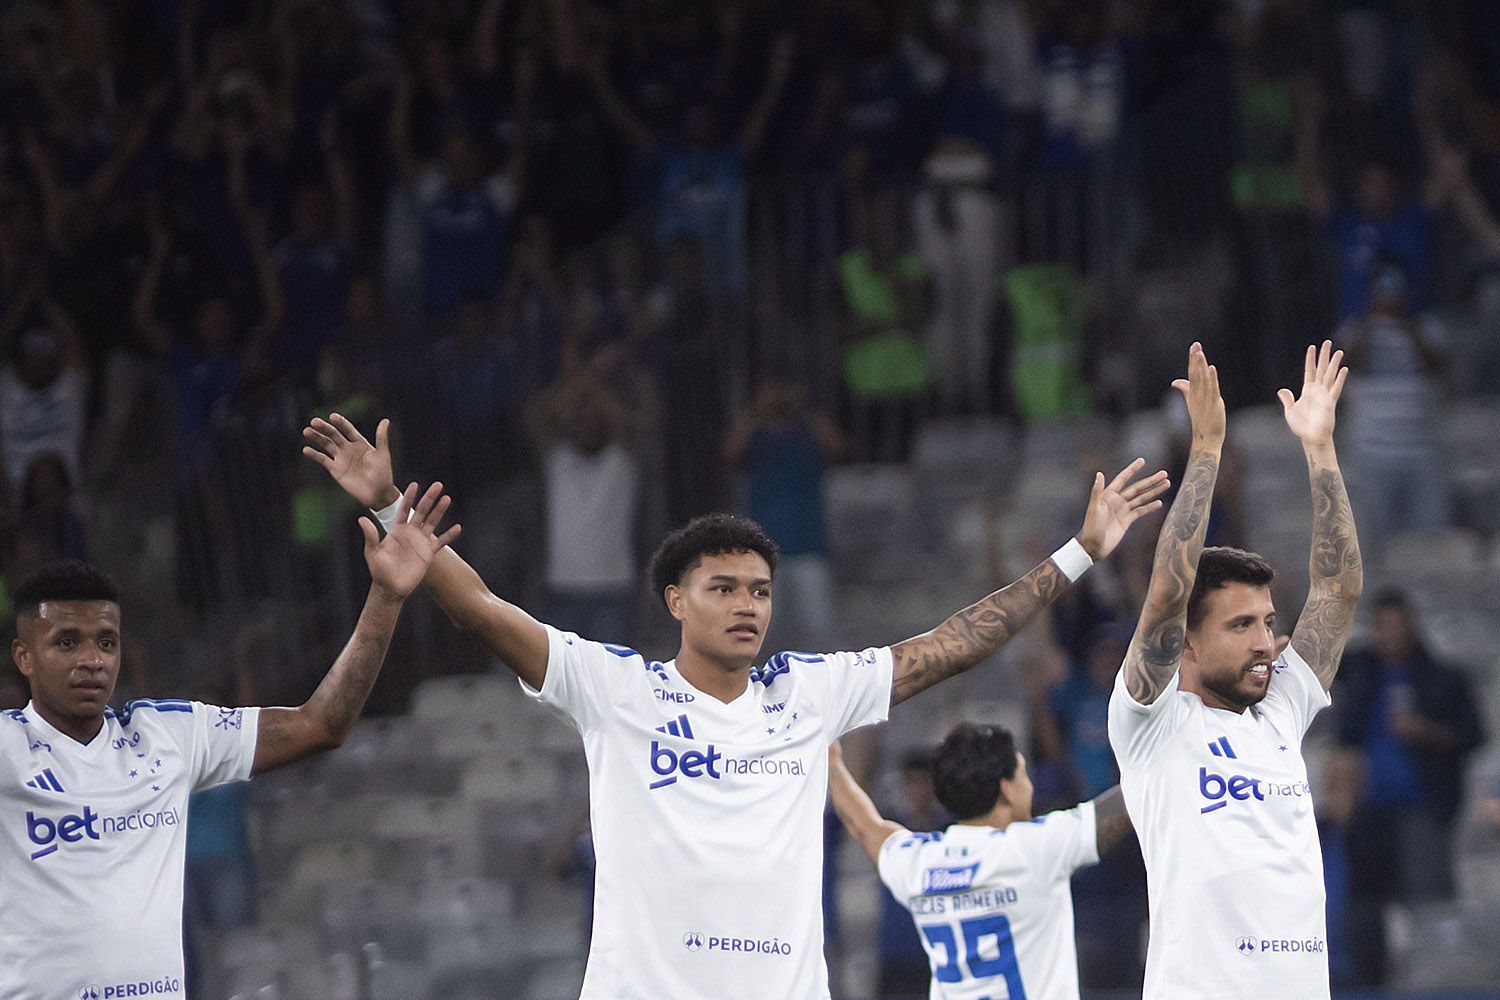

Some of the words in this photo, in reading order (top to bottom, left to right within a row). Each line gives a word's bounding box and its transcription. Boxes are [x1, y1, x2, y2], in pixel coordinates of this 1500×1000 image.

[653, 688, 695, 703] CIMED
[650, 741, 721, 779] bet
[725, 754, 806, 777] nacional
[1200, 767, 1264, 801] bet
[26, 806, 101, 844] bet
[102, 807, 180, 834] nacional
[708, 938, 792, 956] PERDIGÃO
[104, 976, 179, 999] PERDIGÃO
